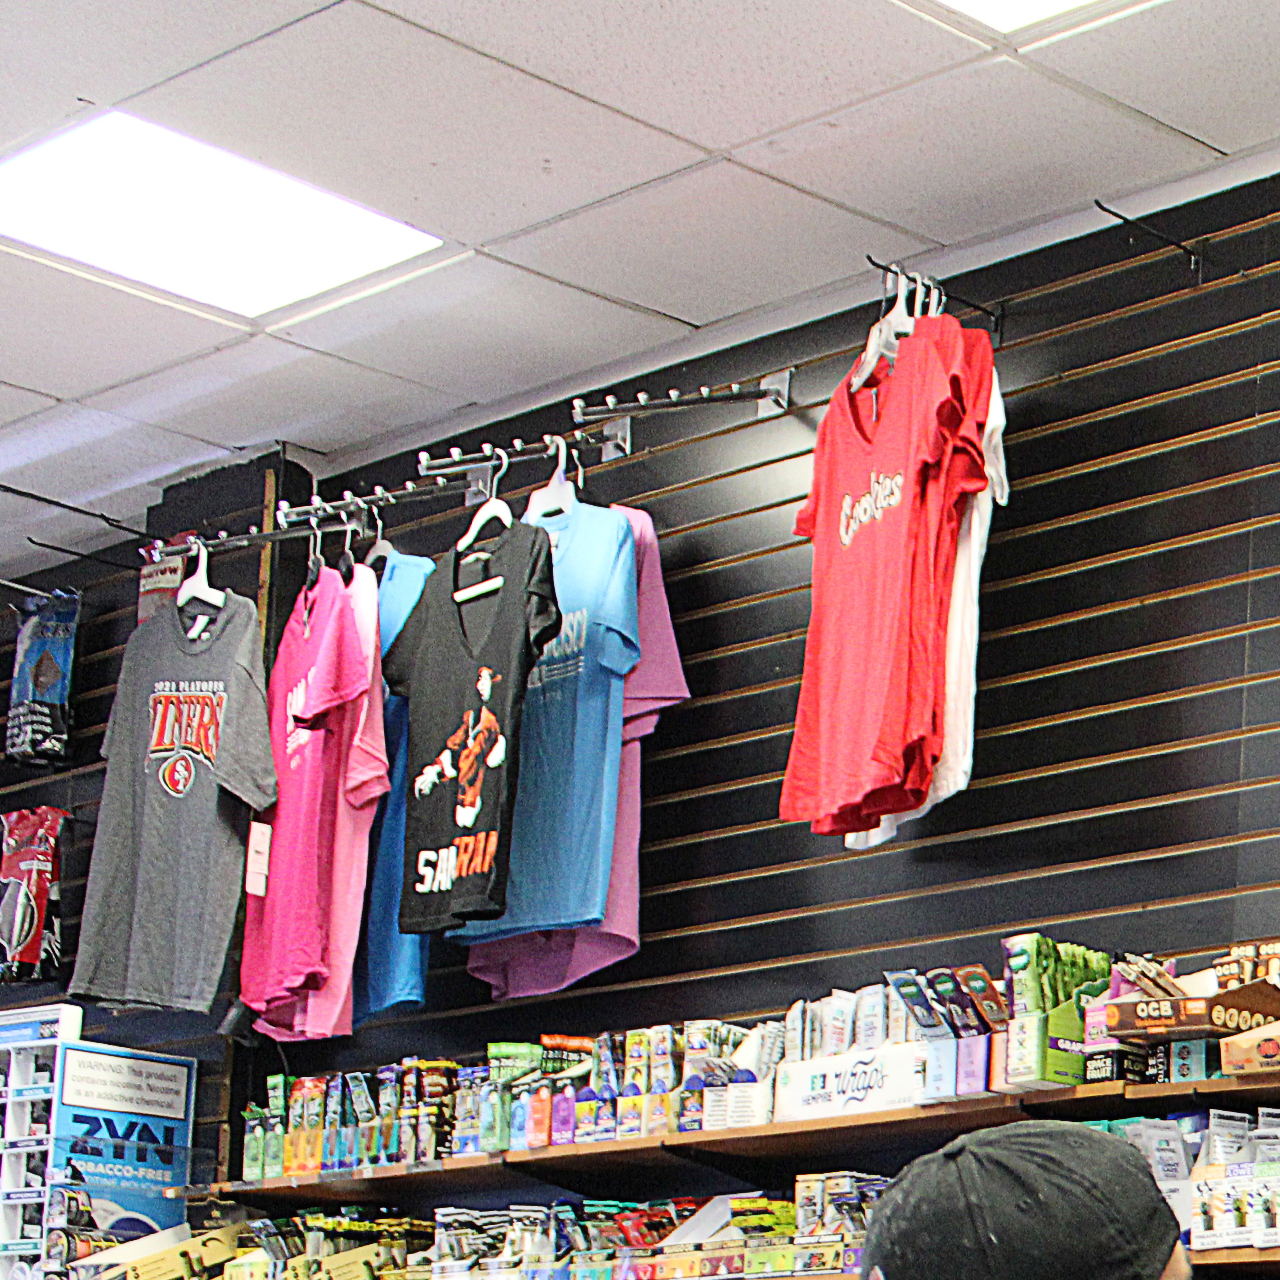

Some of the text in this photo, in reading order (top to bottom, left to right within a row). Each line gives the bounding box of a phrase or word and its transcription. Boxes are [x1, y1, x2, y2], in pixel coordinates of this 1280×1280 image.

[839, 471, 904, 546] Cookies
[1231, 944, 1254, 959] OCB
[1216, 961, 1239, 976] OCB
[1136, 1001, 1173, 1018] OCB
[77, 1058, 178, 1083] WARNING: product
[71, 1074, 108, 1086] contains
[69, 1112, 176, 1166] ZYN
